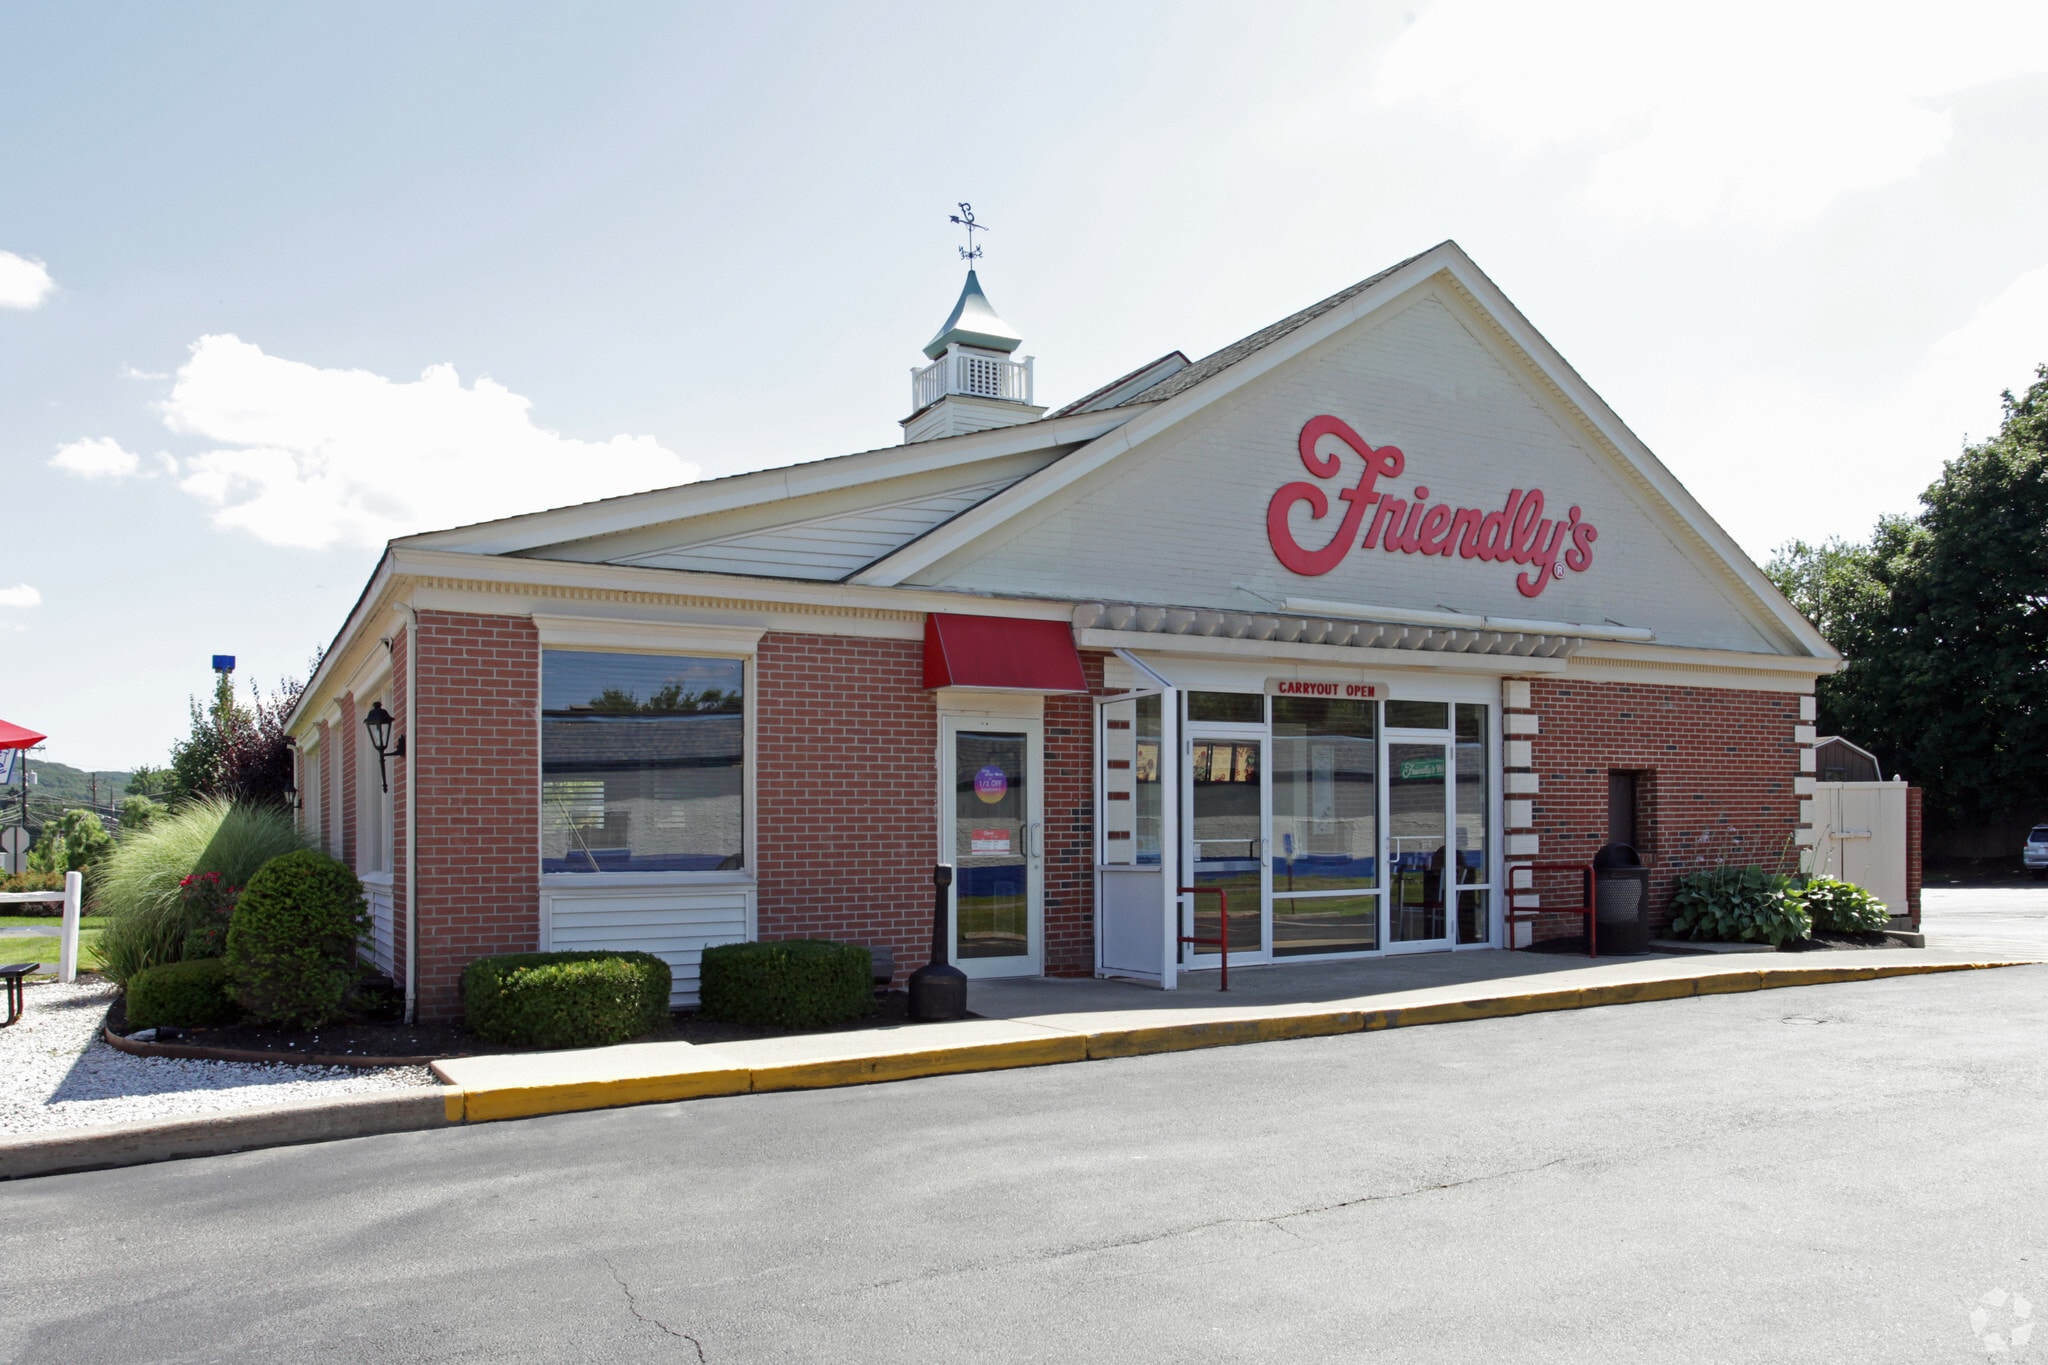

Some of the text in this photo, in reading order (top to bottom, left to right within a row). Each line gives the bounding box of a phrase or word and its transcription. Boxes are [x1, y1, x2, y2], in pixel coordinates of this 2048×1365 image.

[1267, 414, 1597, 597] Friendly's
[1279, 681, 1375, 698] CARRYOUT OPEN
